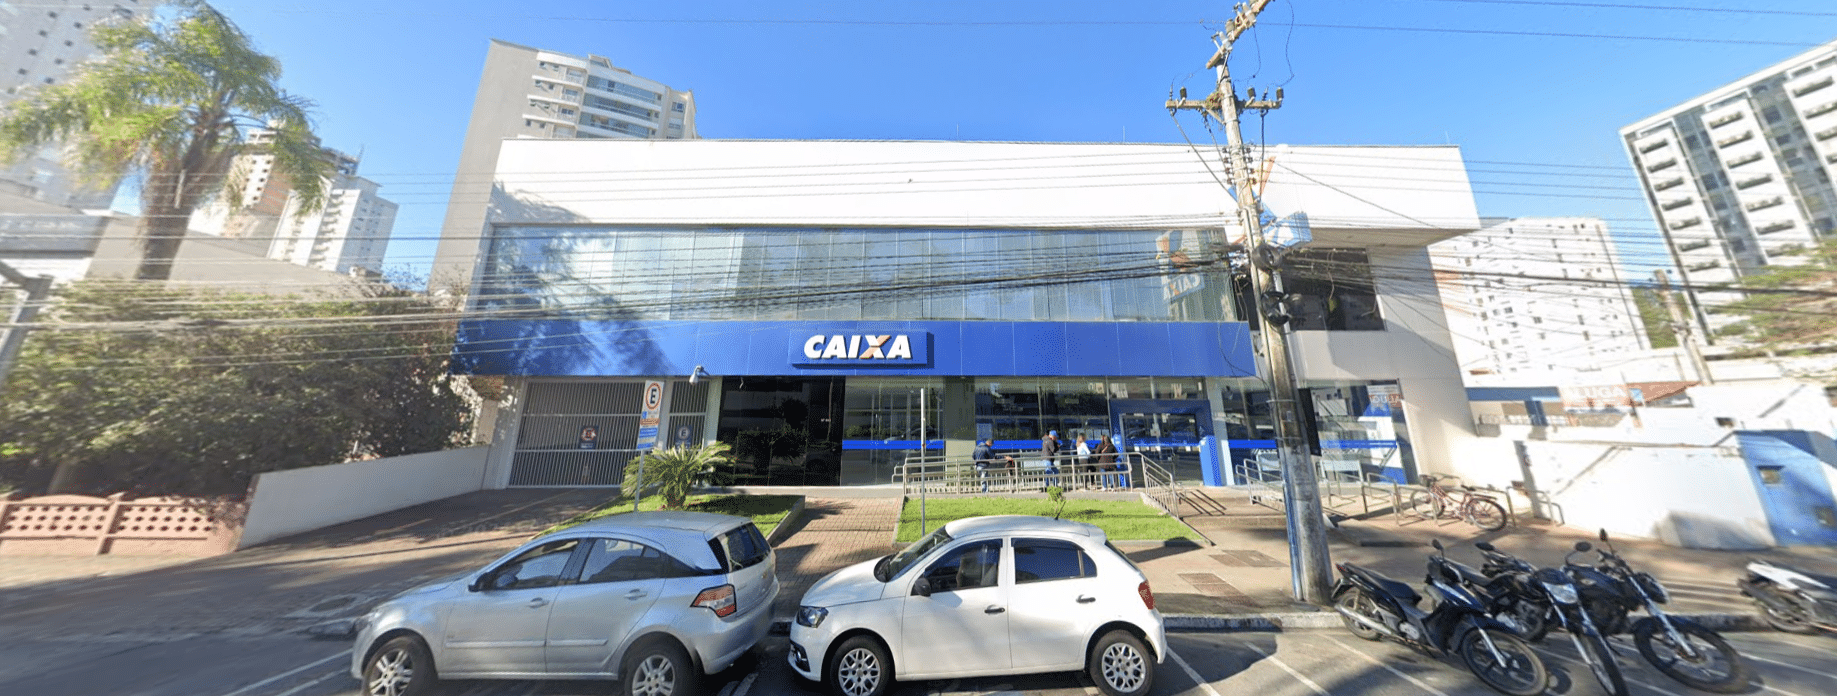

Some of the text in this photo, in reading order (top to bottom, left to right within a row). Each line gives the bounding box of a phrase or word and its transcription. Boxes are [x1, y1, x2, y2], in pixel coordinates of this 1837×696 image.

[804, 334, 912, 359] CAIXA
[650, 388, 657, 404] E
[1564, 386, 1626, 398] LUGA
